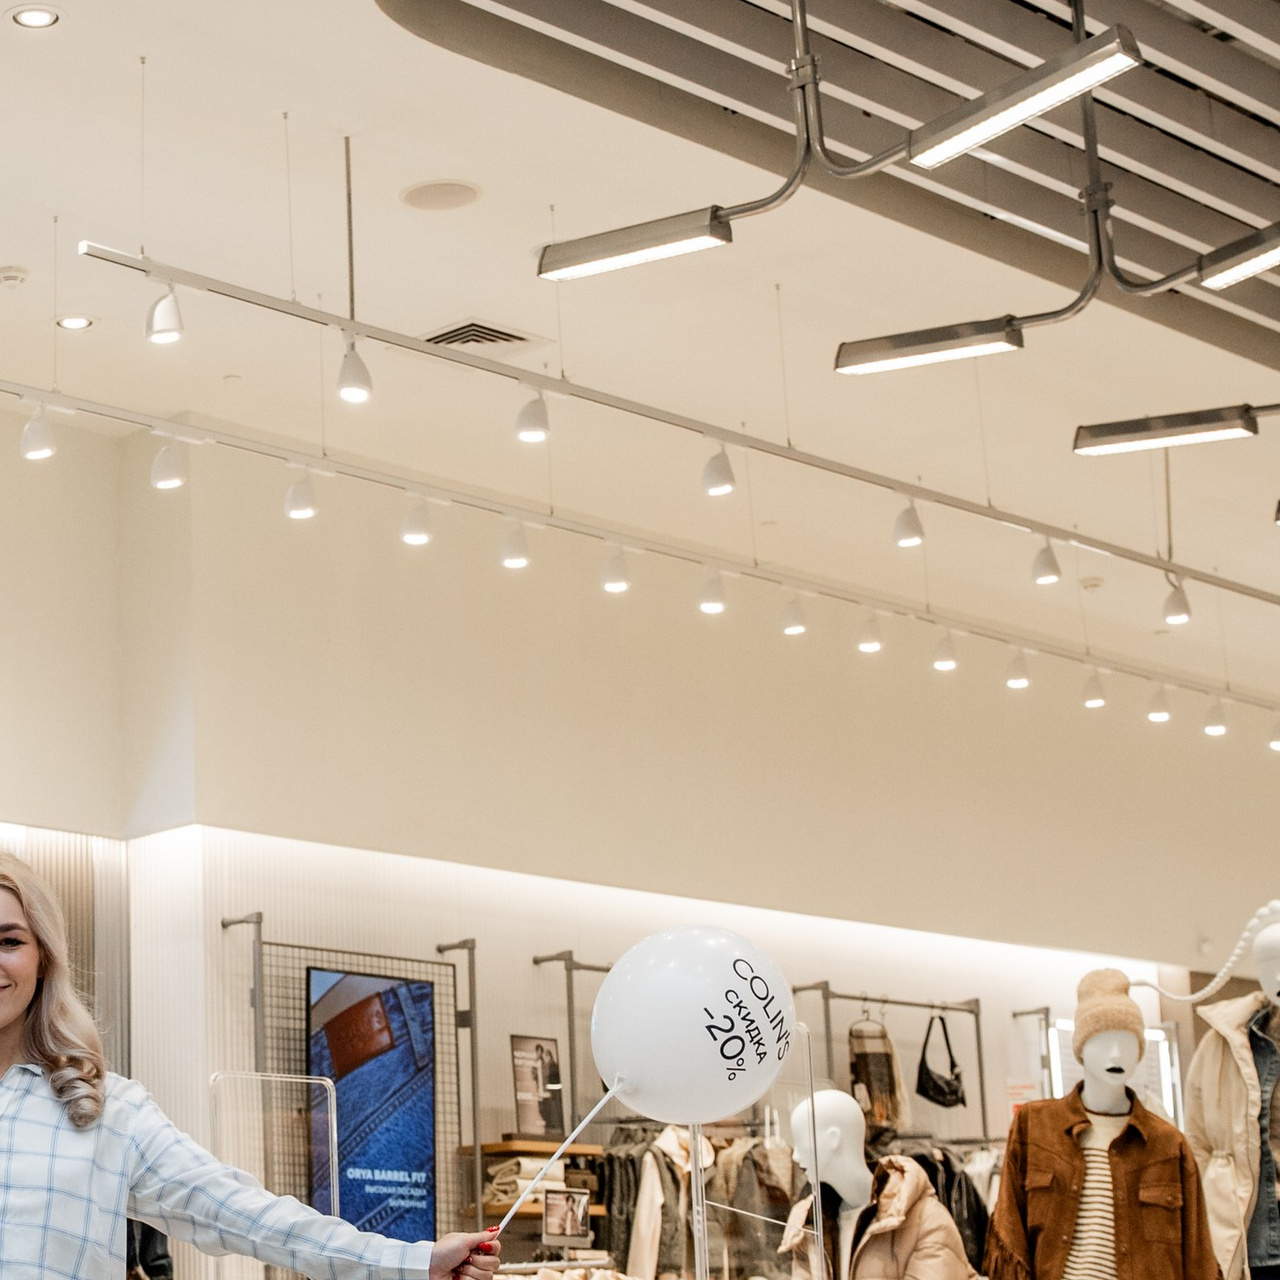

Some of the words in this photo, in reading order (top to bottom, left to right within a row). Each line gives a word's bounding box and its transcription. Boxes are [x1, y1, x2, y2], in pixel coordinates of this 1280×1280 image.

[703, 1006, 747, 1081] -20%
[724, 989, 768, 1065] СКИДКА
[732, 958, 791, 1061] COLIN'S
